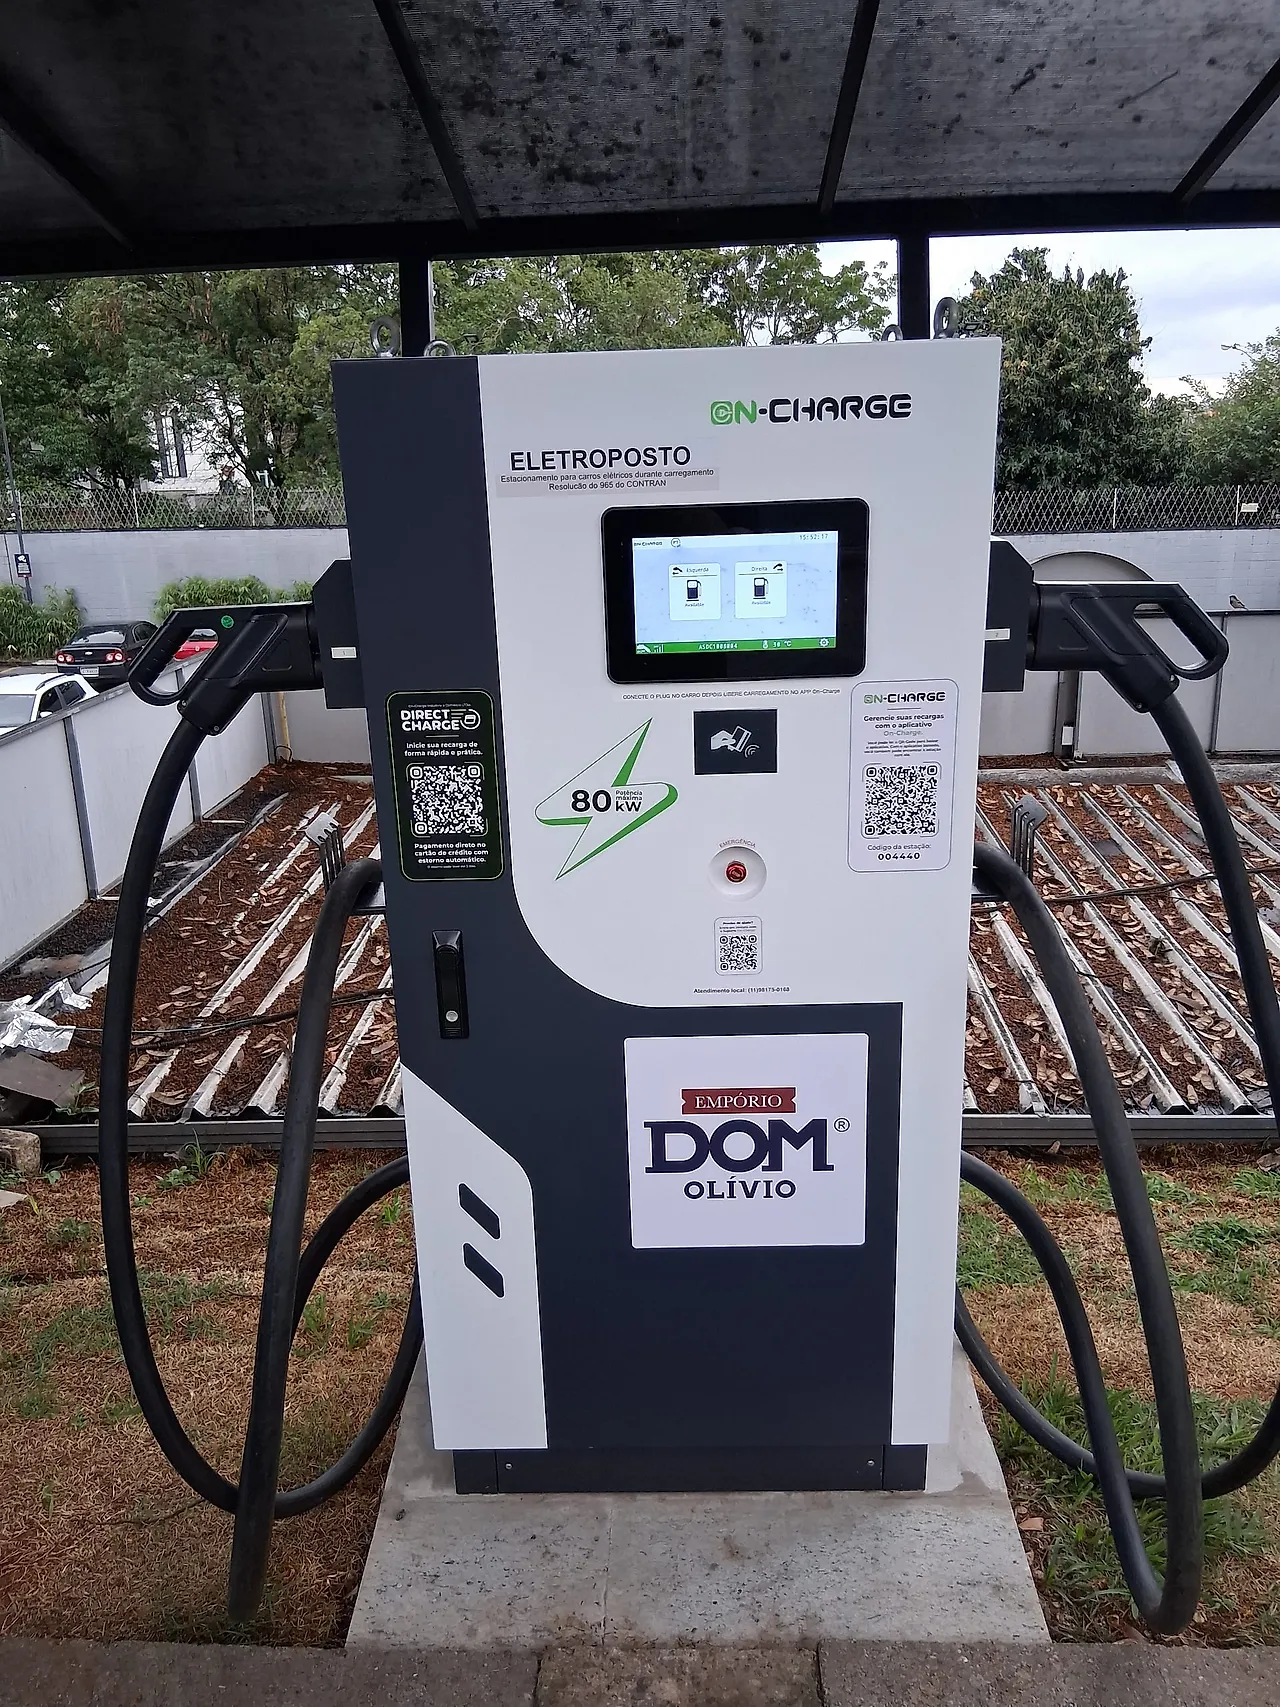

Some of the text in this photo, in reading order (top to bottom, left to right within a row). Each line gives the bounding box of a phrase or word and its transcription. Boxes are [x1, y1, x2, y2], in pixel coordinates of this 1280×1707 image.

[711, 393, 912, 425] ON-CHARGE
[510, 446, 691, 471] ELETROPOSTO
[501, 474, 558, 483] Estacionamento
[560, 474, 576, 482] para
[603, 470, 633, 479] elétricos
[635, 470, 662, 478] durante
[664, 468, 714, 478] carregamento
[589, 481, 598, 489] do
[600, 481, 613, 489] 965
[626, 479, 667, 488] CONTRAN
[864, 692, 946, 704] ON-CHARGE
[401, 709, 450, 720] DIRECT
[402, 720, 460, 731] CHARGE
[898, 721, 932, 729] aplicativo
[427, 749, 450, 757] rápida
[457, 748, 483, 757] prática.
[571, 789, 612, 812] 80
[615, 800, 642, 812] kW
[414, 842, 454, 850] Pagamento
[719, 838, 756, 848] EMERGÊNCIA
[445, 855, 487, 863] automático.
[877, 852, 920, 860] 004440
[695, 1092, 782, 1109] EMPÓRIO
[643, 1118, 835, 1174] DOM
[684, 1176, 796, 1199] OLÍVIO
